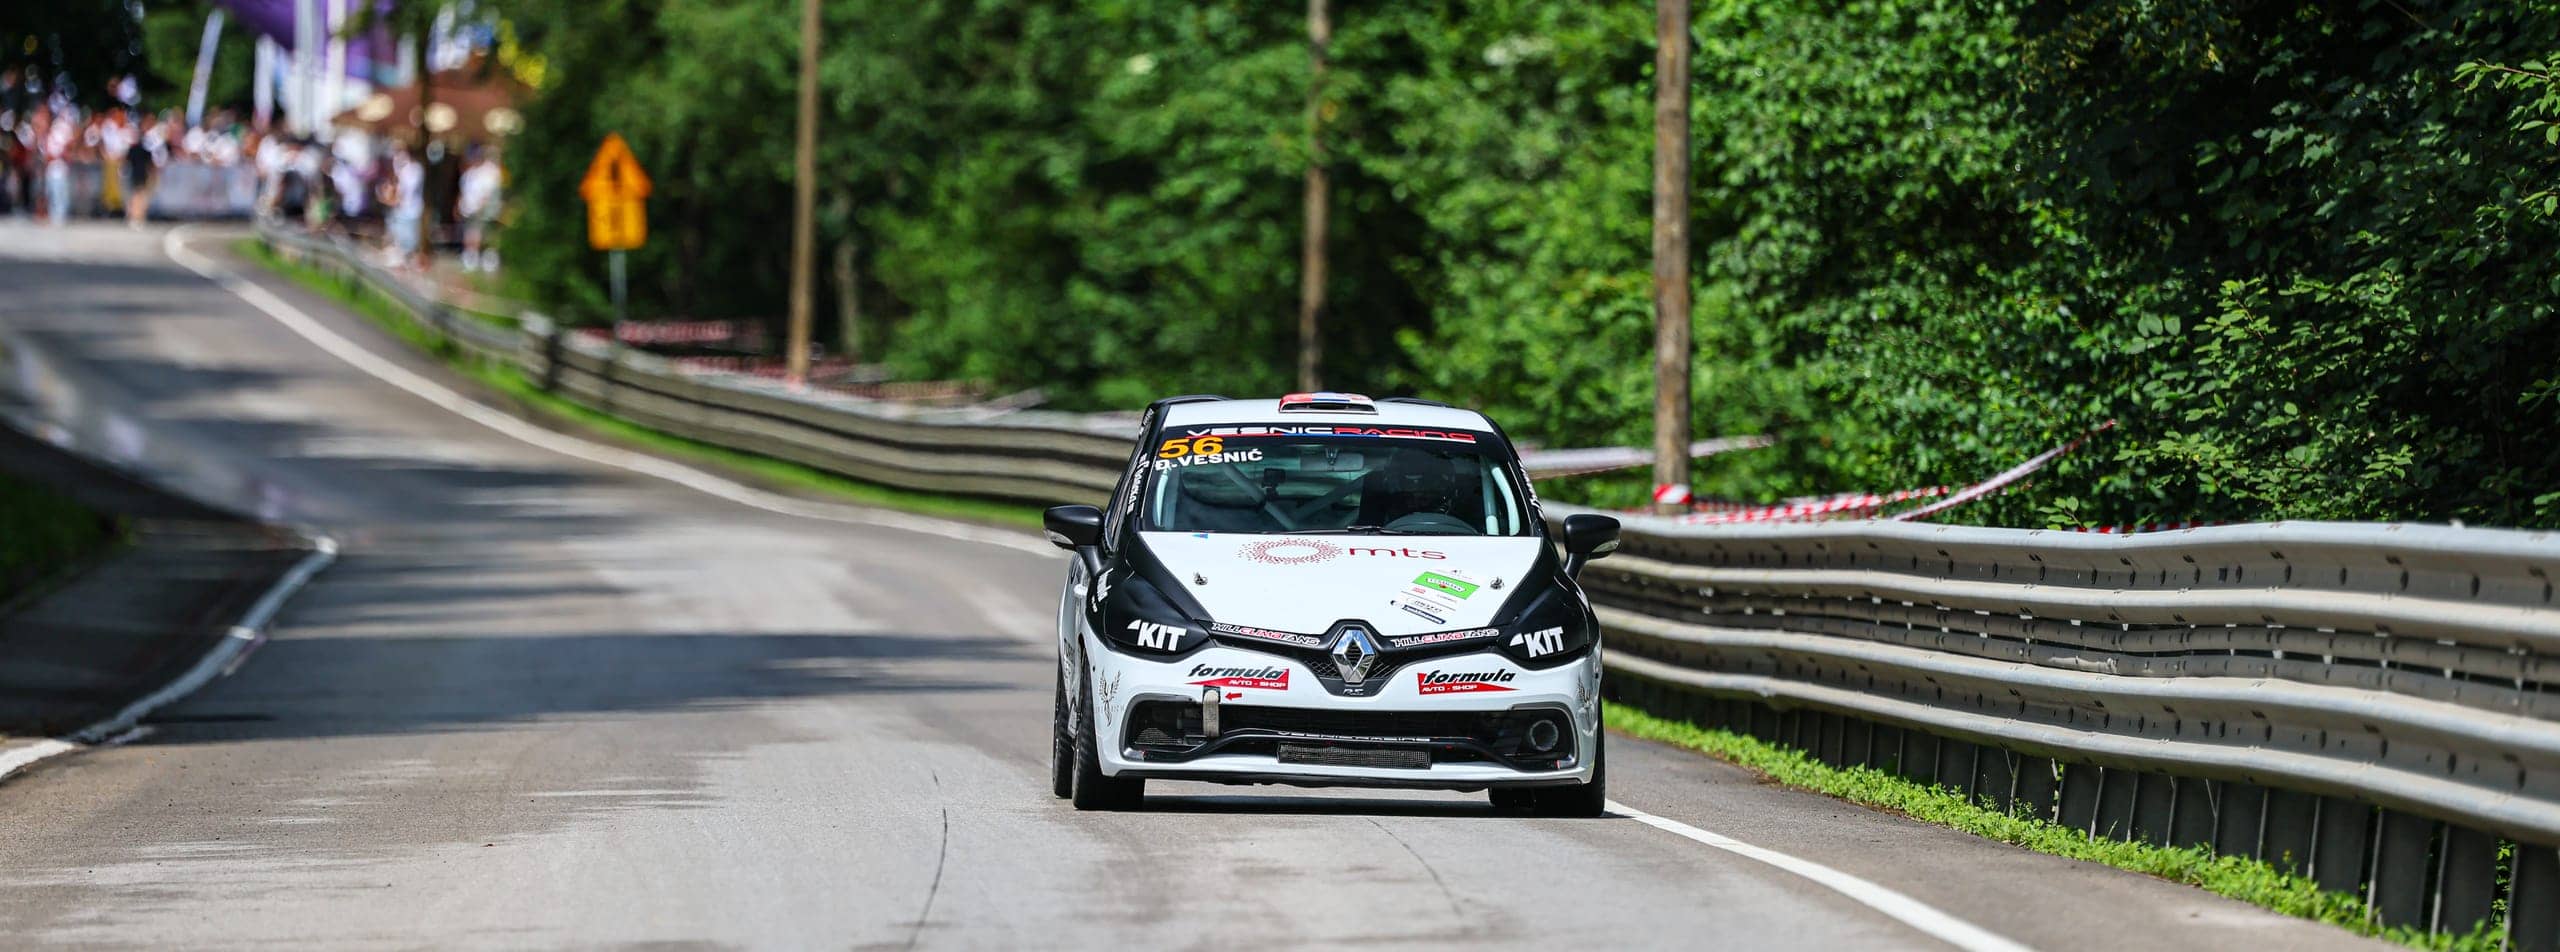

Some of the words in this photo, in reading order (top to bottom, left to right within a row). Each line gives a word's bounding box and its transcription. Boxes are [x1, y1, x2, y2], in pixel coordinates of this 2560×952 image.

[1159, 436, 1224, 459] 56
[1349, 547, 1447, 560] mts
[1187, 663, 1284, 679] formula
[1424, 668, 1517, 684] formula
[1228, 679, 1253, 687] AVTO
[1259, 680, 1287, 688] SHOP
